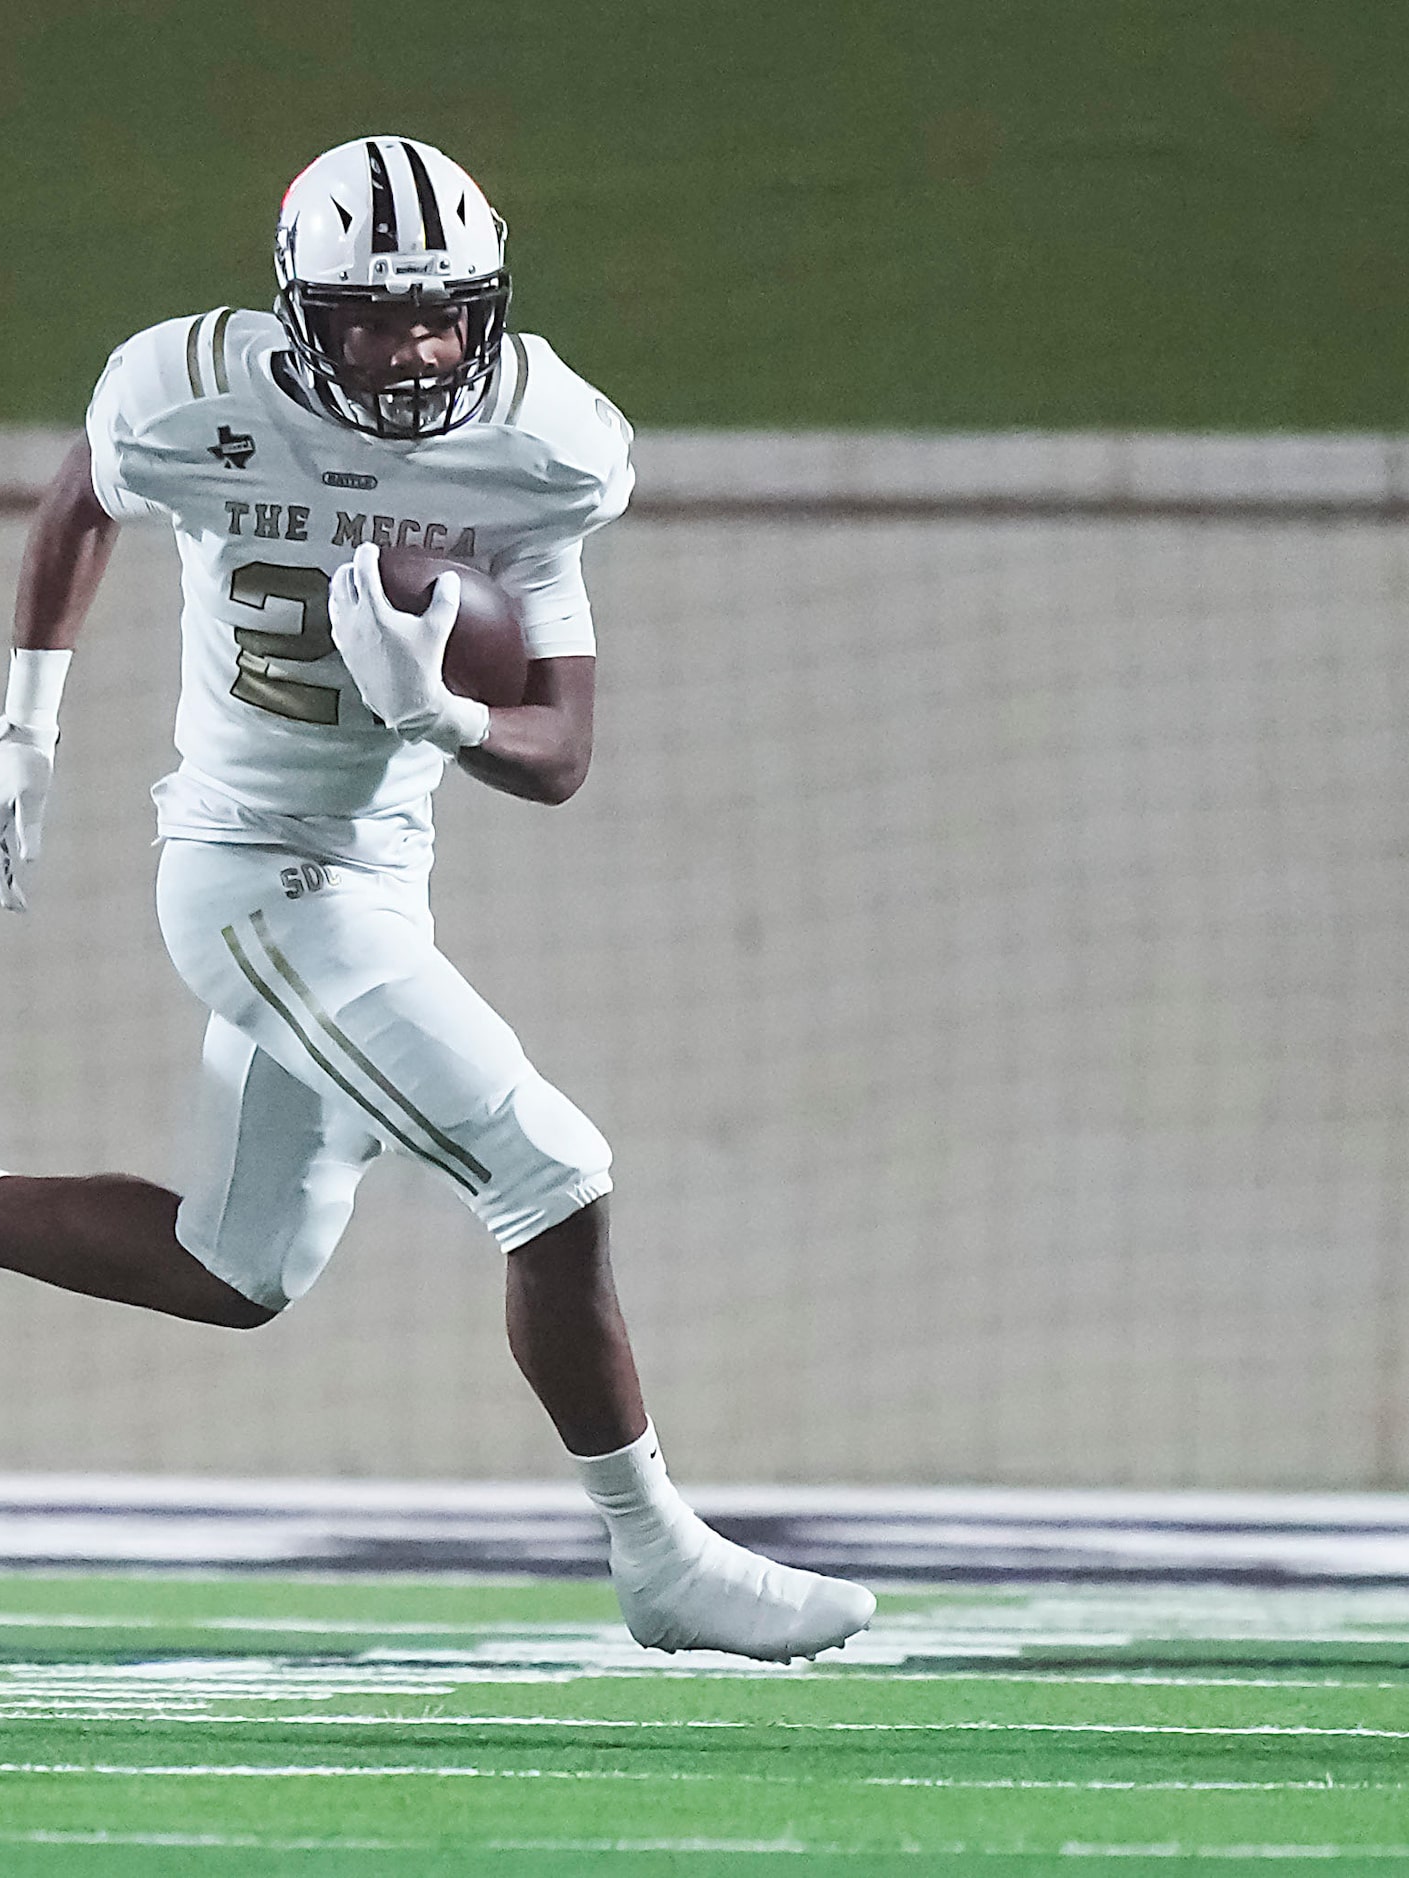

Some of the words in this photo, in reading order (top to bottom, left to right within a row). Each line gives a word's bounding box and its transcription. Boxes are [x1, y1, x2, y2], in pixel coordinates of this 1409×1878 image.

[225, 500, 310, 542] THE
[331, 511, 476, 557] MECCA
[229, 560, 389, 726] 2
